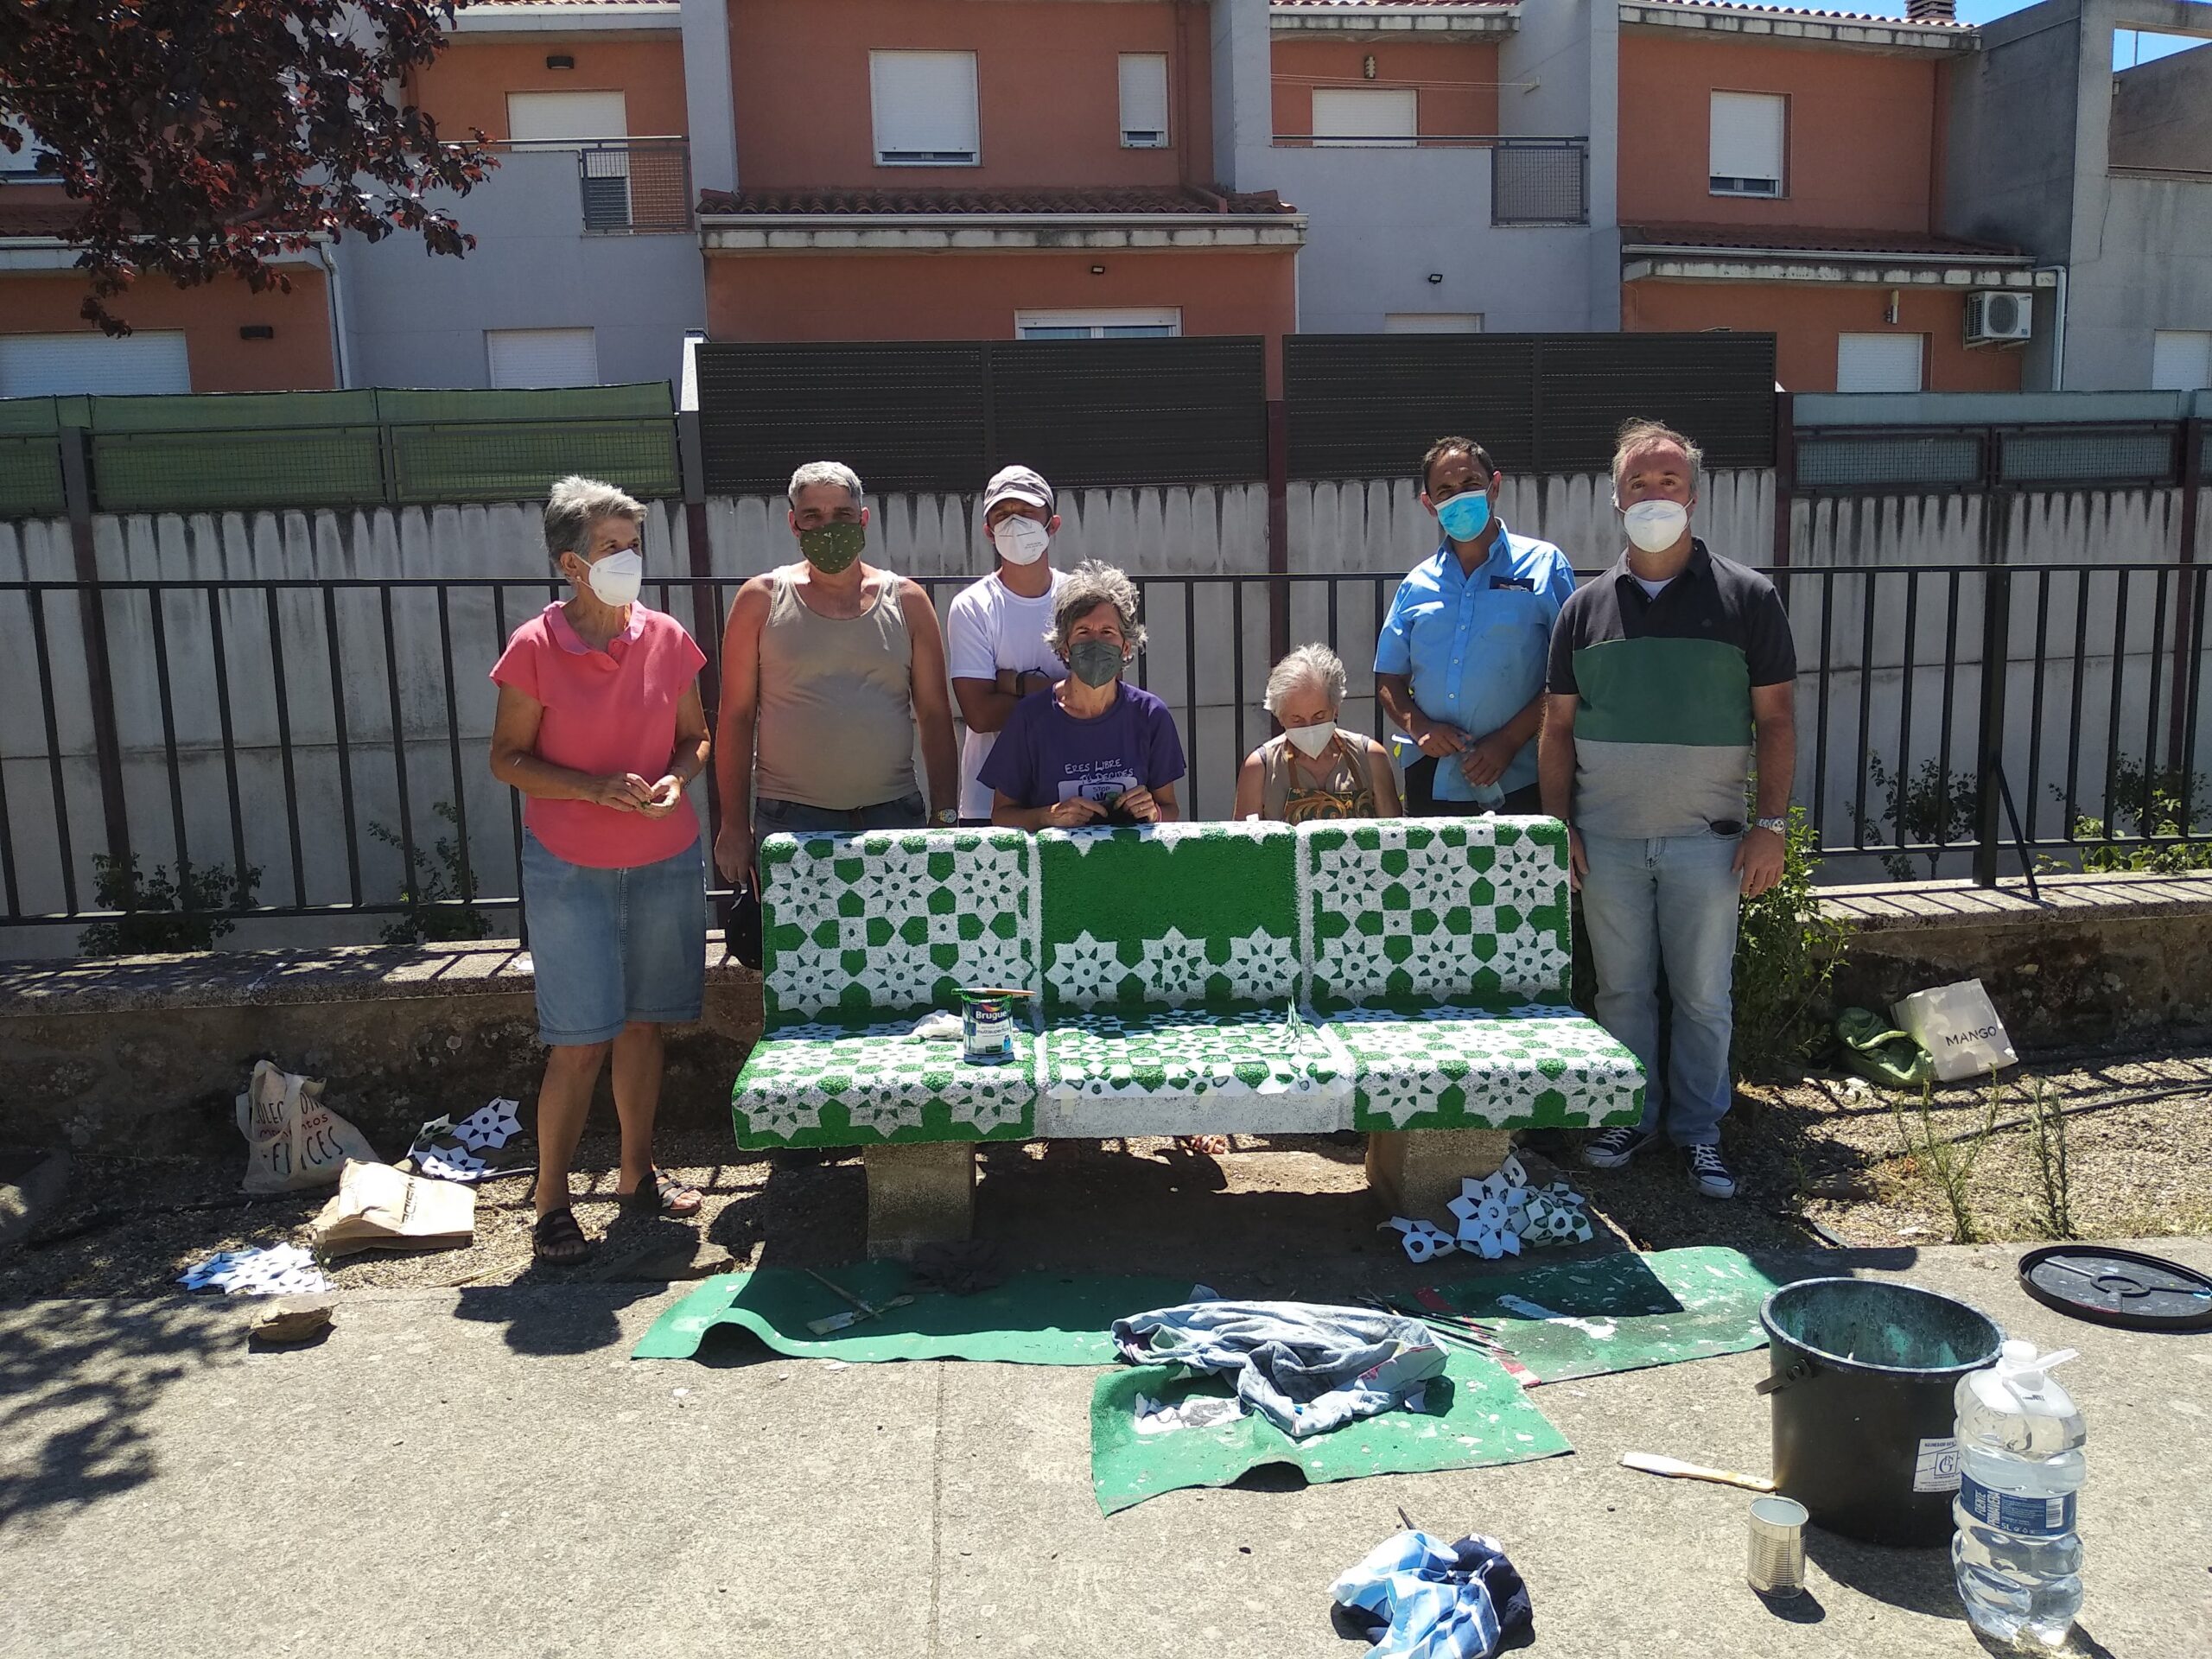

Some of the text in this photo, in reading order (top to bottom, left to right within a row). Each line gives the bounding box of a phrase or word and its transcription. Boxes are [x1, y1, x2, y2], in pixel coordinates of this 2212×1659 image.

[1065, 759, 1122, 774] ERES LIBRE
[1095, 768, 1134, 784] DECIDES
[976, 1010, 1009, 1020] Brugue
[1945, 1026, 1997, 1047] MANGO
[1986, 1489, 2001, 1529] PRIMAVERA
